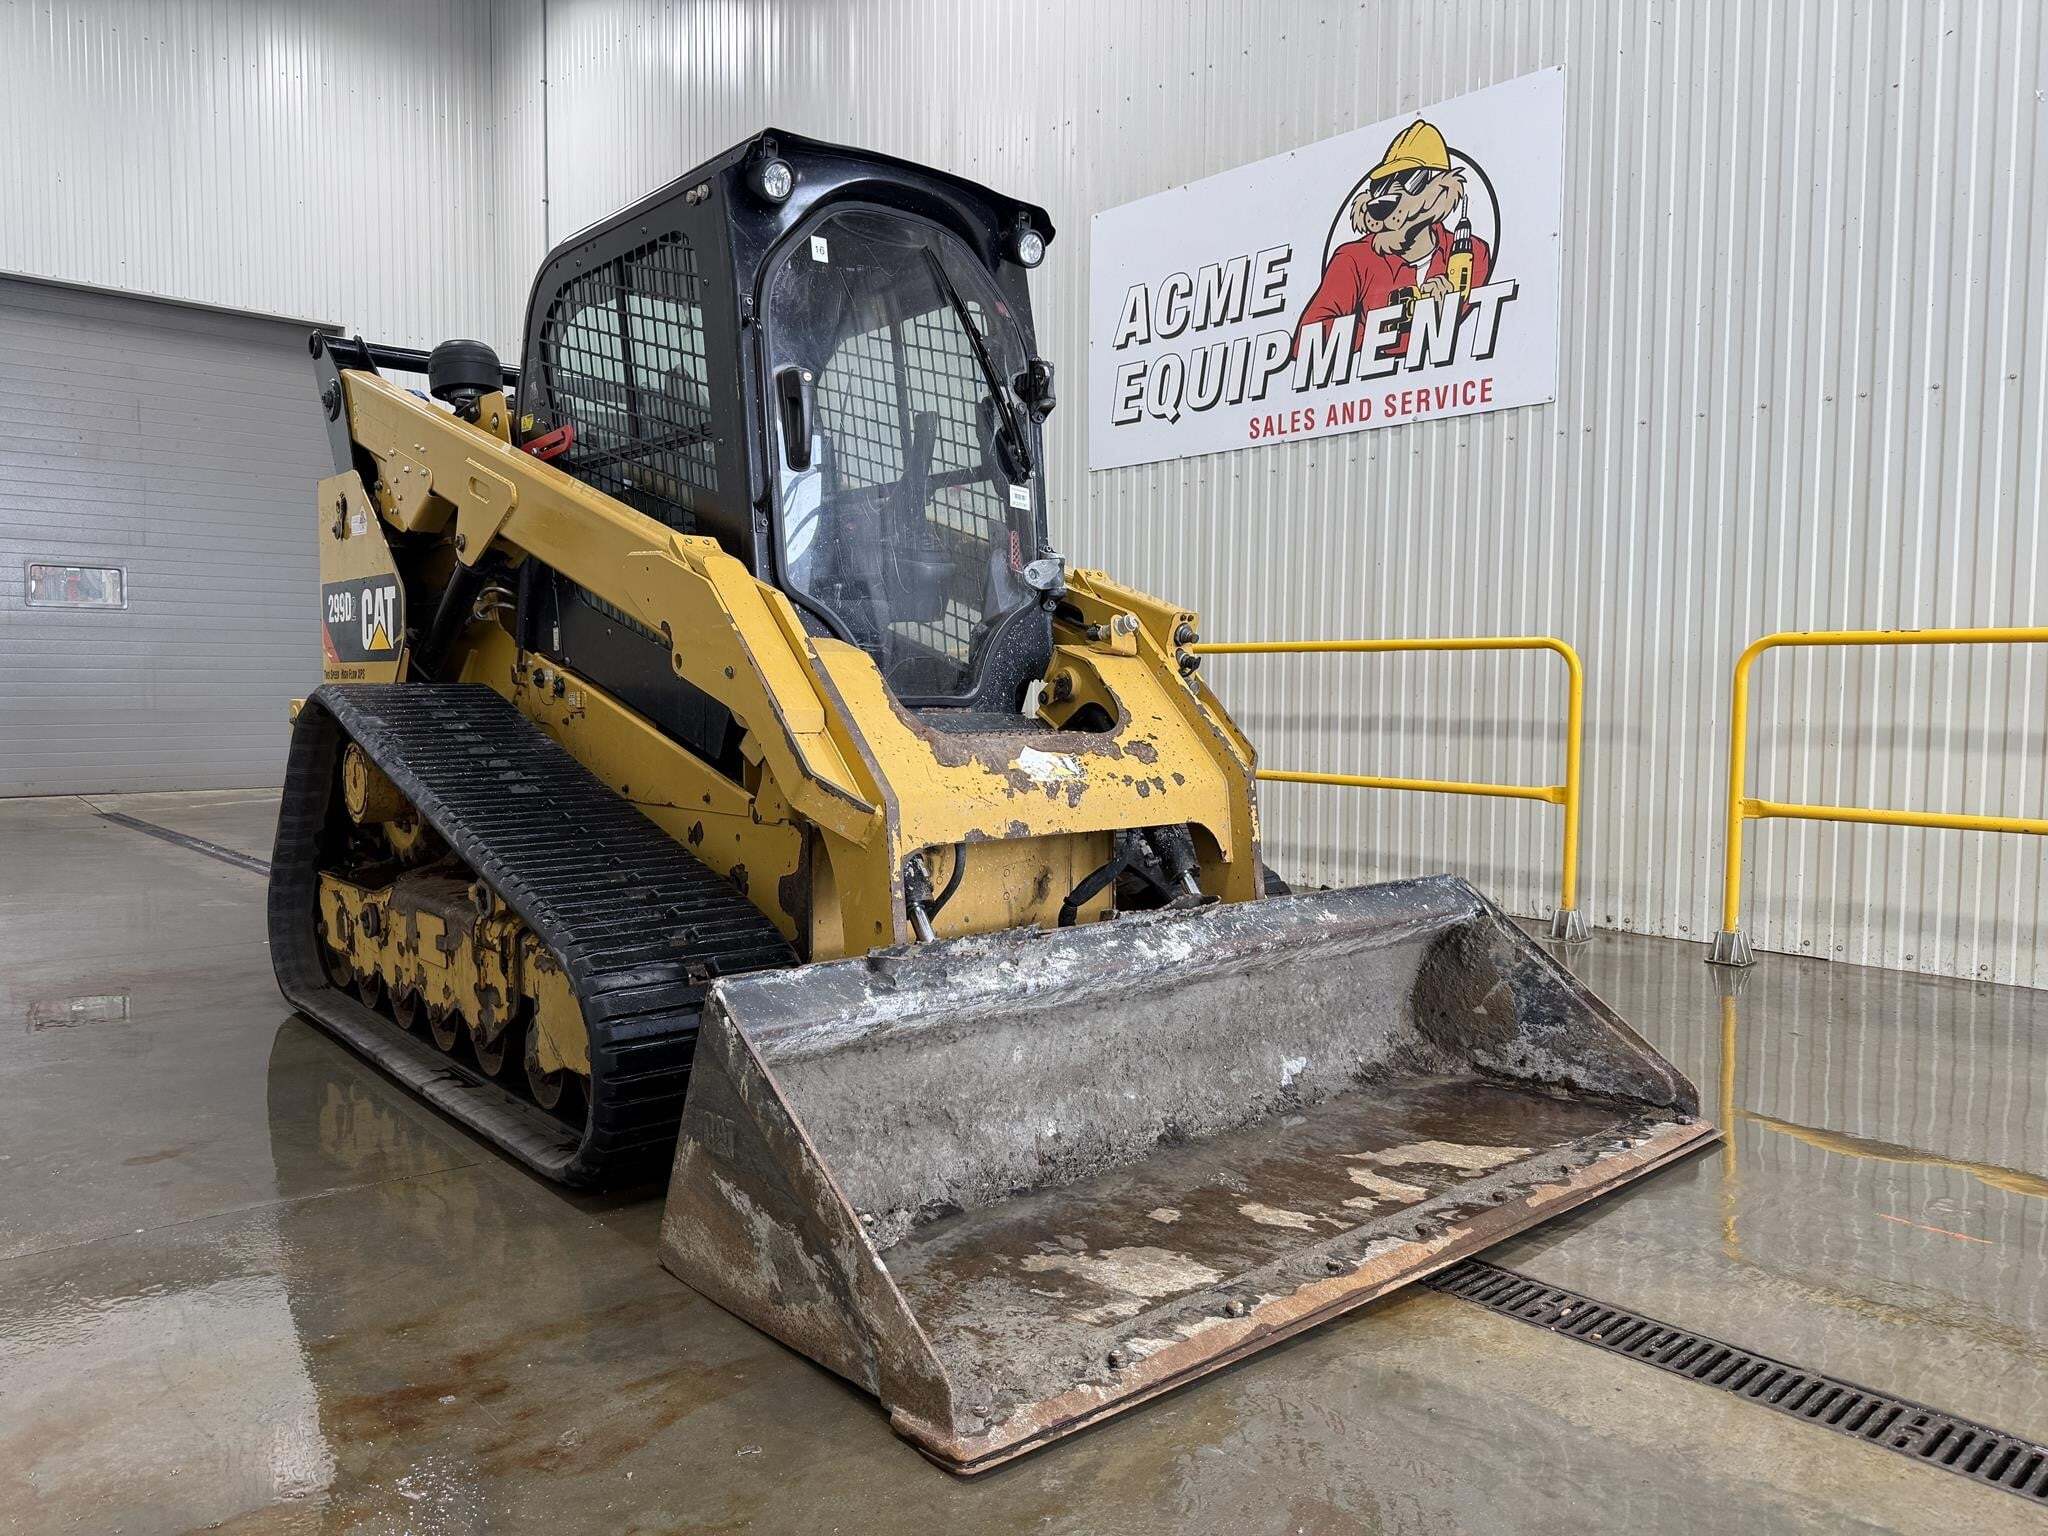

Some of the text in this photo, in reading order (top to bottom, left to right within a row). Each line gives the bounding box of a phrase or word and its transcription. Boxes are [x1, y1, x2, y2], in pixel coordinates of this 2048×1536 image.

[1112, 243, 1293, 351] ACME
[1111, 278, 1520, 426] EQUIPMENT
[1249, 377, 1494, 440] SALES AND SERVICE
[361, 585, 396, 651] CAT
